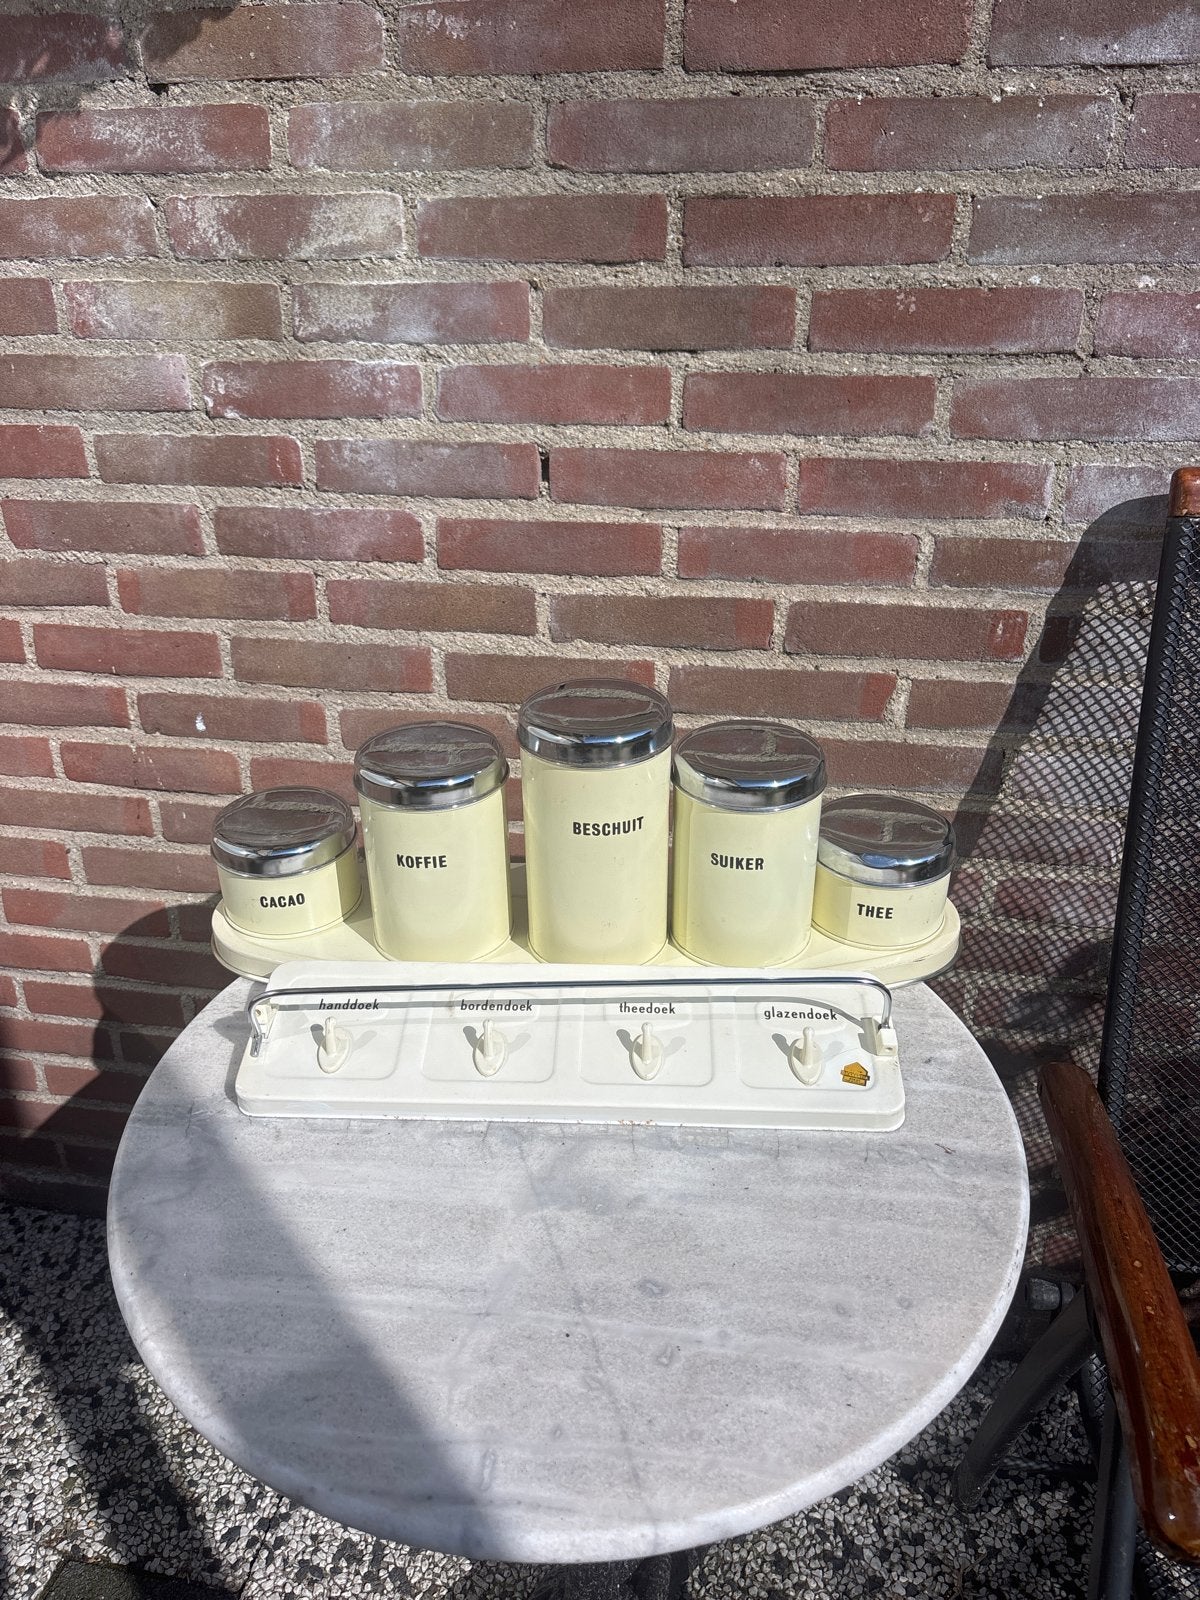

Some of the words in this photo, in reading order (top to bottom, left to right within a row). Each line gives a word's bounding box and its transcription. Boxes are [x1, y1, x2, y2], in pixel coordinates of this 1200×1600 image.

[572, 815, 645, 837] BESCHUIT
[396, 853, 448, 869] KOFFIE
[710, 852, 764, 871] SUIKER
[259, 892, 306, 909] CACAO
[856, 902, 894, 921] THEE
[318, 998, 380, 1011] handdoek
[460, 998, 533, 1012] bordendoek
[619, 1002, 676, 1015] theedoek
[764, 1006, 838, 1021] glazendoek
